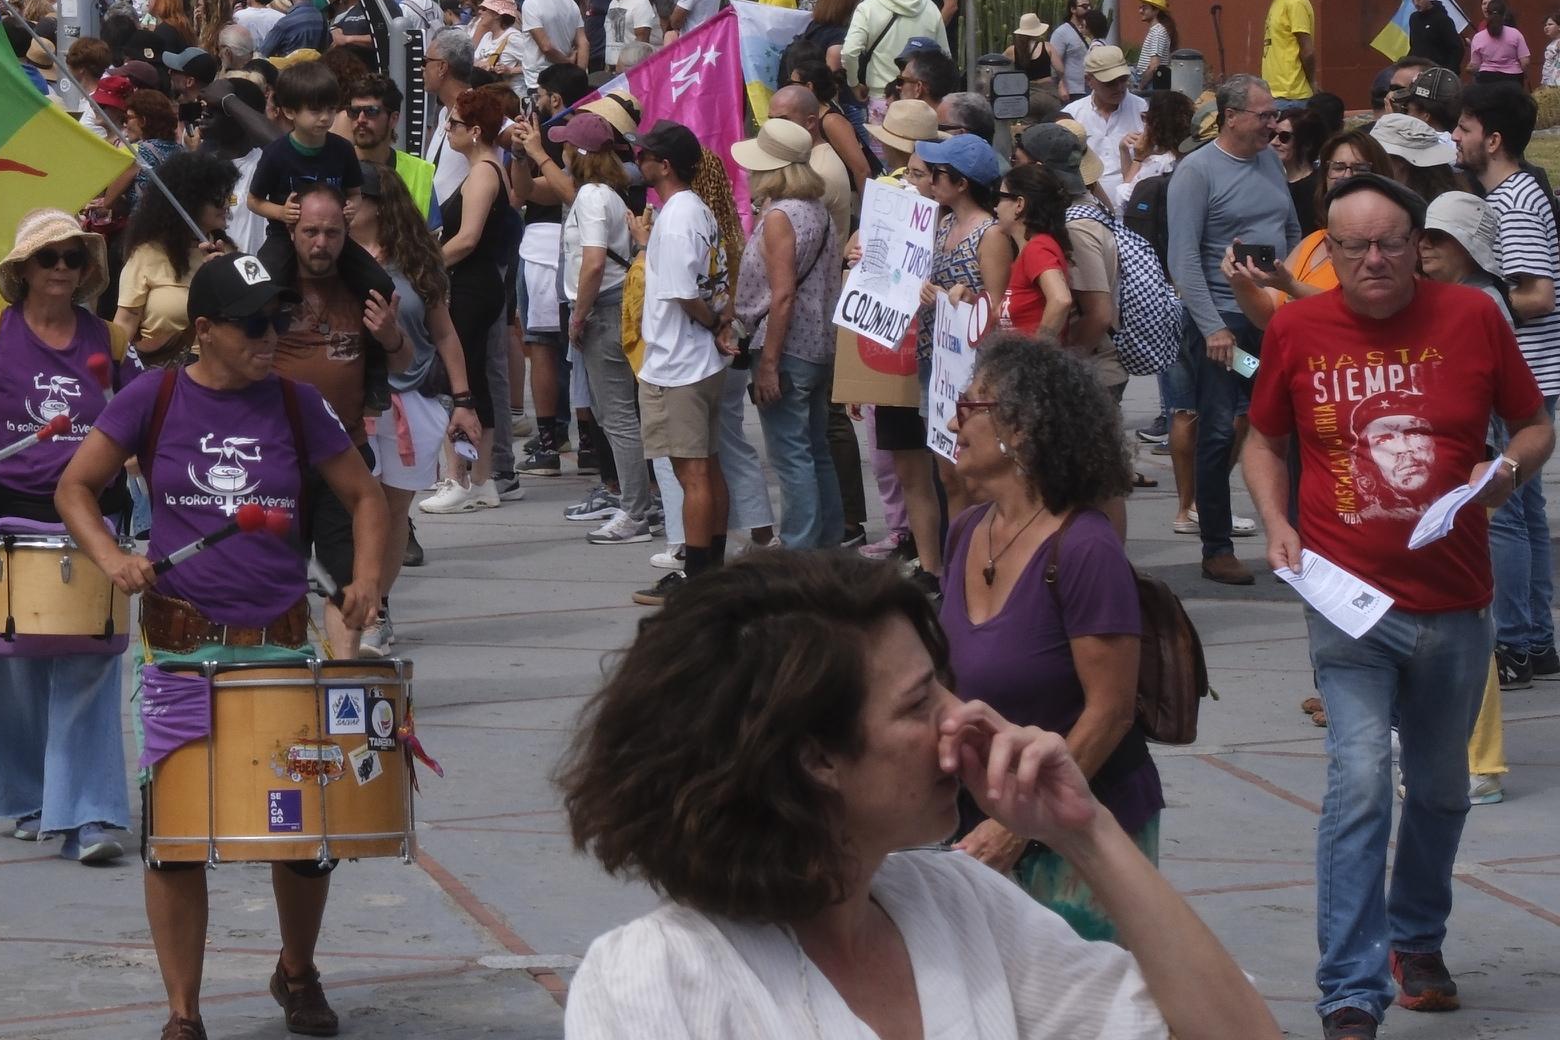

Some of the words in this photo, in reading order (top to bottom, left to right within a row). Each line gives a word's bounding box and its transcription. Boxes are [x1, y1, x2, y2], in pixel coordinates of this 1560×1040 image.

[910, 201, 932, 232] NO
[1307, 346, 1443, 371] HASTA
[165, 492, 176, 505] la
[270, 792, 281, 800] SE
[271, 808, 284, 816] CA
